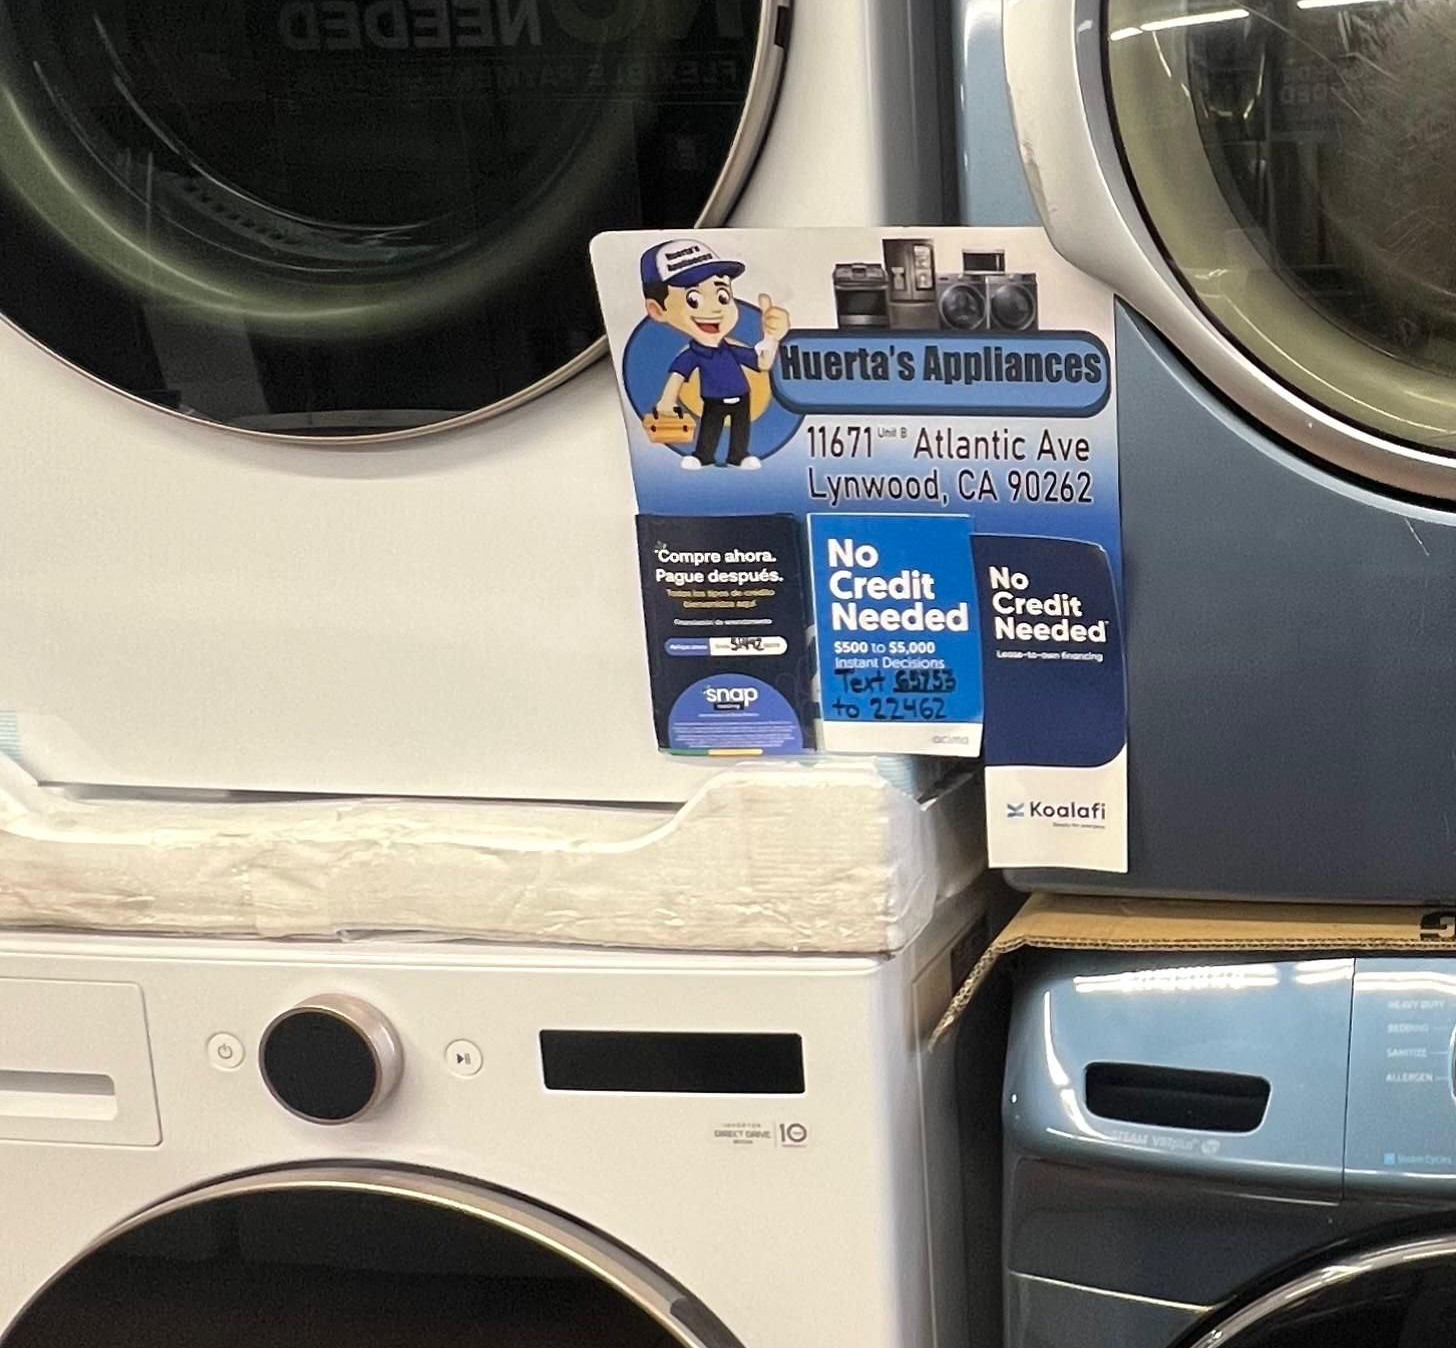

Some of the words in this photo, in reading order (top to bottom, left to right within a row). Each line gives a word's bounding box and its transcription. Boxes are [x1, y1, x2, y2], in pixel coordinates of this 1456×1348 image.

[779, 344, 917, 383] Huerta's
[923, 345, 1104, 386] Appliances
[807, 424, 873, 459] 11671
[913, 427, 1027, 462] Atlantic
[1036, 429, 1091, 462] Ave
[808, 467, 950, 507] Lynwood,
[958, 469, 996, 502] CA
[1007, 470, 1093, 504] 90262
[658, 549, 721, 566] Compre
[724, 549, 777, 563] ahora.
[828, 538, 879, 567] No
[656, 568, 704, 586] Pague
[707, 568, 784, 586] después.
[829, 569, 936, 600] Credit
[988, 566, 1029, 590] No
[831, 602, 969, 632] Needed
[991, 591, 1083, 618] Credit
[993, 616, 1108, 643] Needed
[834, 640, 868, 654] $500
[871, 641, 886, 654] to
[1061, 651, 1104, 663] financing
[835, 656, 879, 668] Instant
[882, 656, 945, 669] Decisions
[834, 667, 886, 693] Text
[706, 687, 759, 707] snap
[832, 694, 860, 719] to
[869, 696, 948, 720] 22462
[1029, 801, 1106, 820] Koalafi
[1385, 1072, 1433, 1082] ALLERGEN
